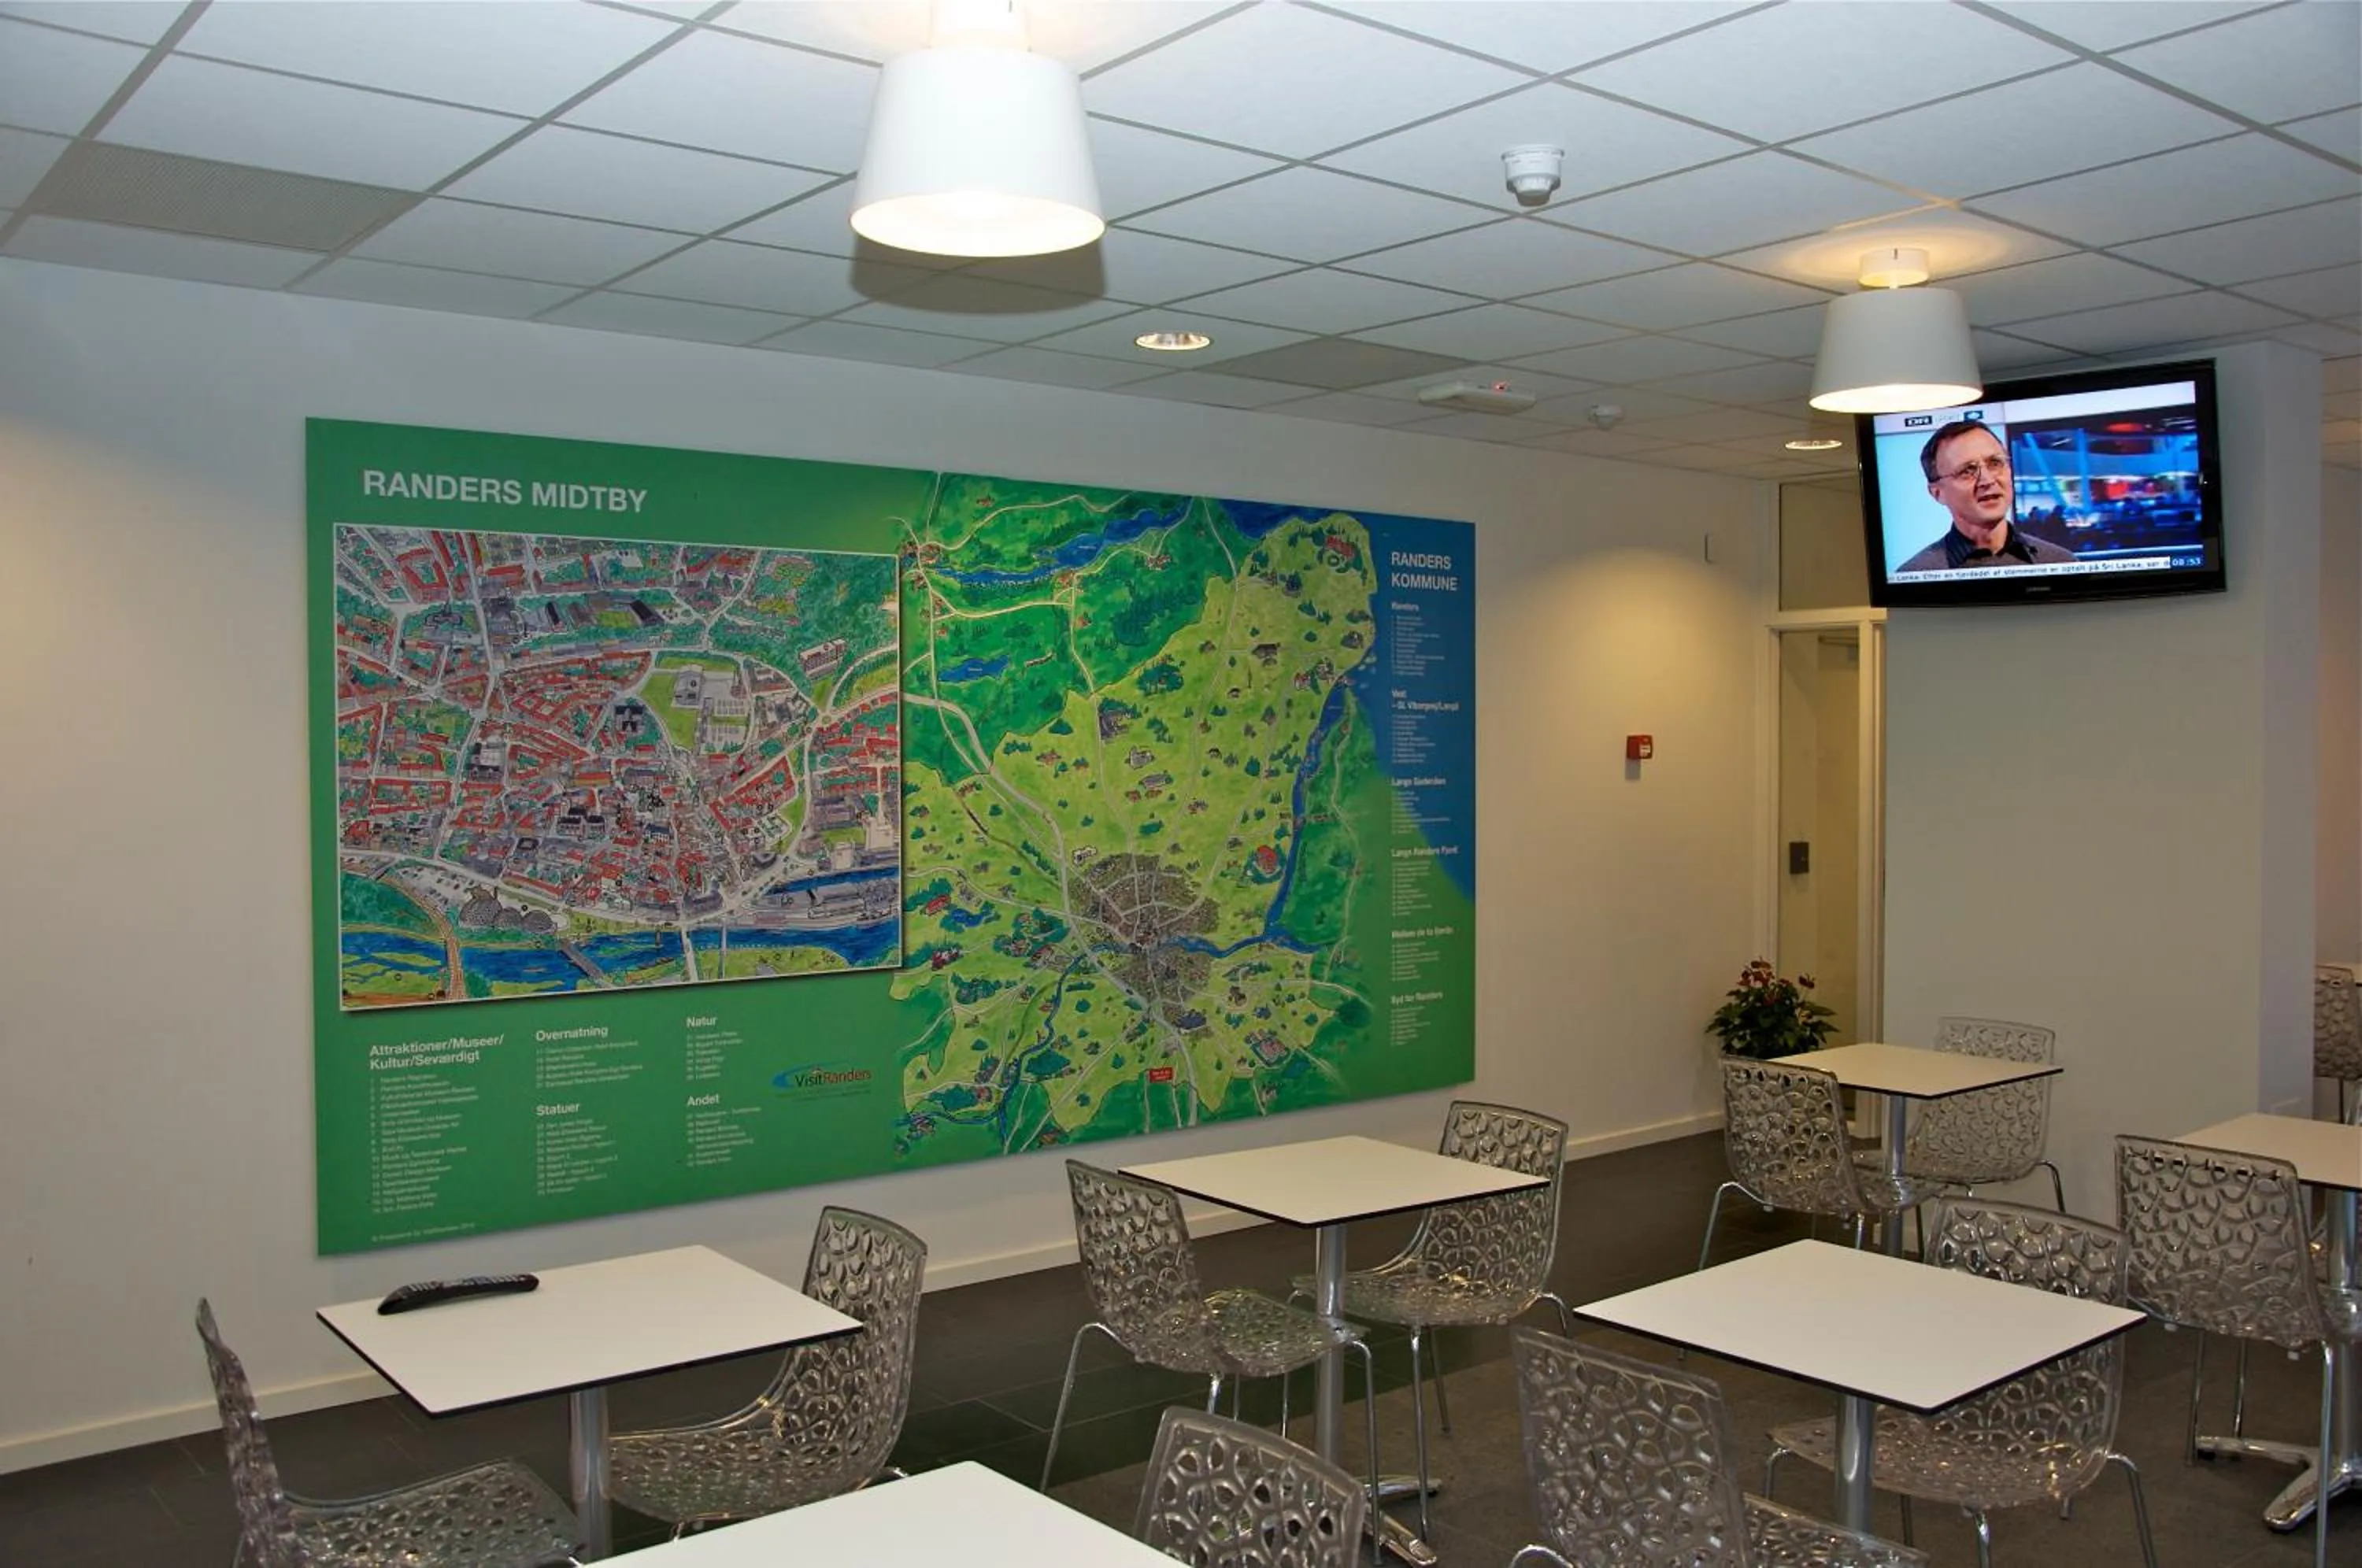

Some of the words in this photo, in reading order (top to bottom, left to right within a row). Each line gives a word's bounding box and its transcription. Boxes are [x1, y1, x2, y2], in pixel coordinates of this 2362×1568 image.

[364, 470, 522, 505] RANDERS
[531, 481, 647, 513] MIDTBY
[1391, 551, 1451, 570] RANDERS
[1391, 572, 1458, 591] KOMMUNE
[686, 1015, 717, 1029] Natur
[536, 1026, 609, 1041] Overnatning
[369, 1033, 504, 1057] Attraktioner/Museer/
[369, 1049, 479, 1071] Kultur/Seværdigt
[536, 1103, 580, 1115] Statuer
[686, 1093, 720, 1107] Andet
